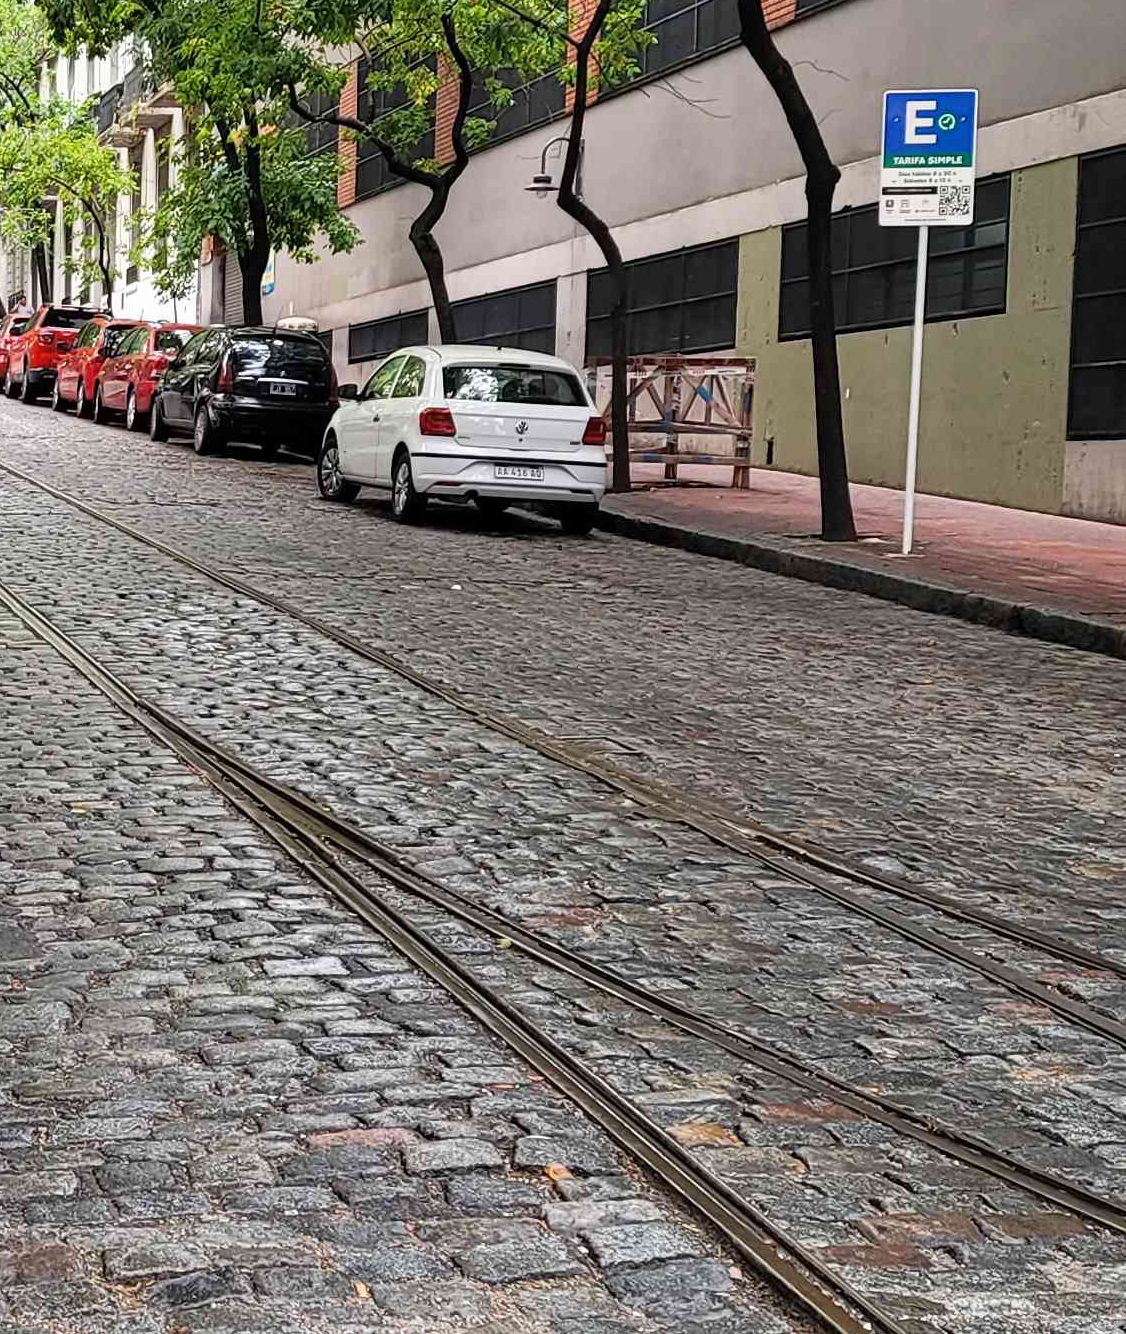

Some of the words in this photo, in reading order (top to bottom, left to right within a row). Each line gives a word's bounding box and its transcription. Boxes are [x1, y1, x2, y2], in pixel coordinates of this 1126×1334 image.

[905, 100, 937, 145] E
[893, 156, 925, 165] TARIFA
[928, 155, 963, 164] SIMPLE
